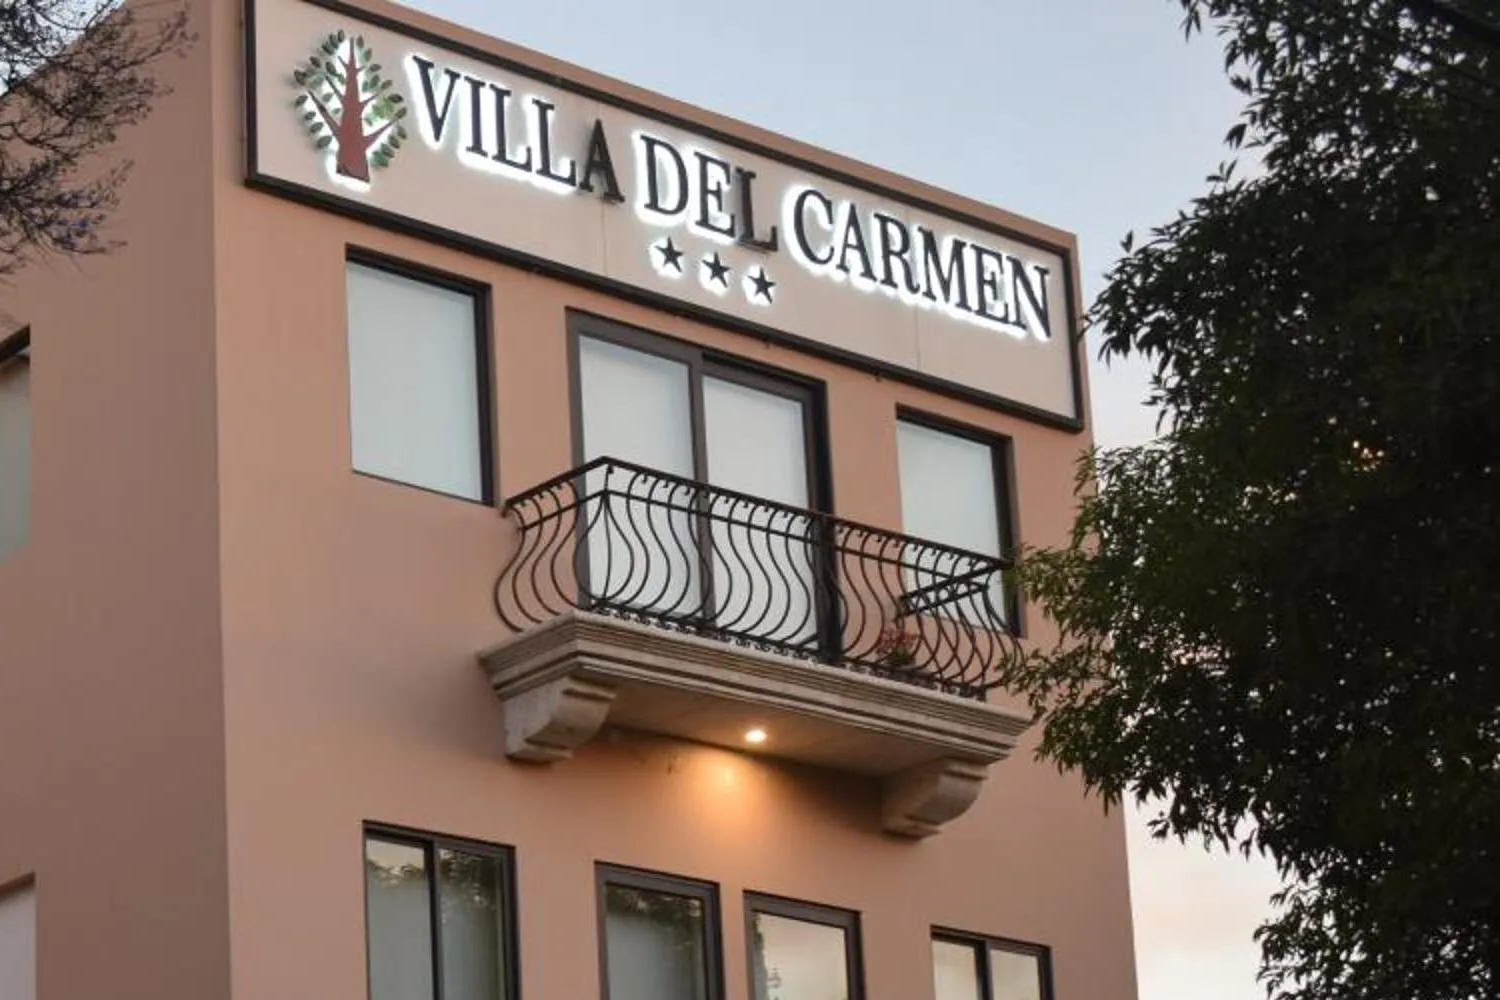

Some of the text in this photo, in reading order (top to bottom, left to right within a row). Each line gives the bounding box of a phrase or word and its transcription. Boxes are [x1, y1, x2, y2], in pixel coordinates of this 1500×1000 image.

[411, 54, 1052, 339] VILLA DEL CARMEN
